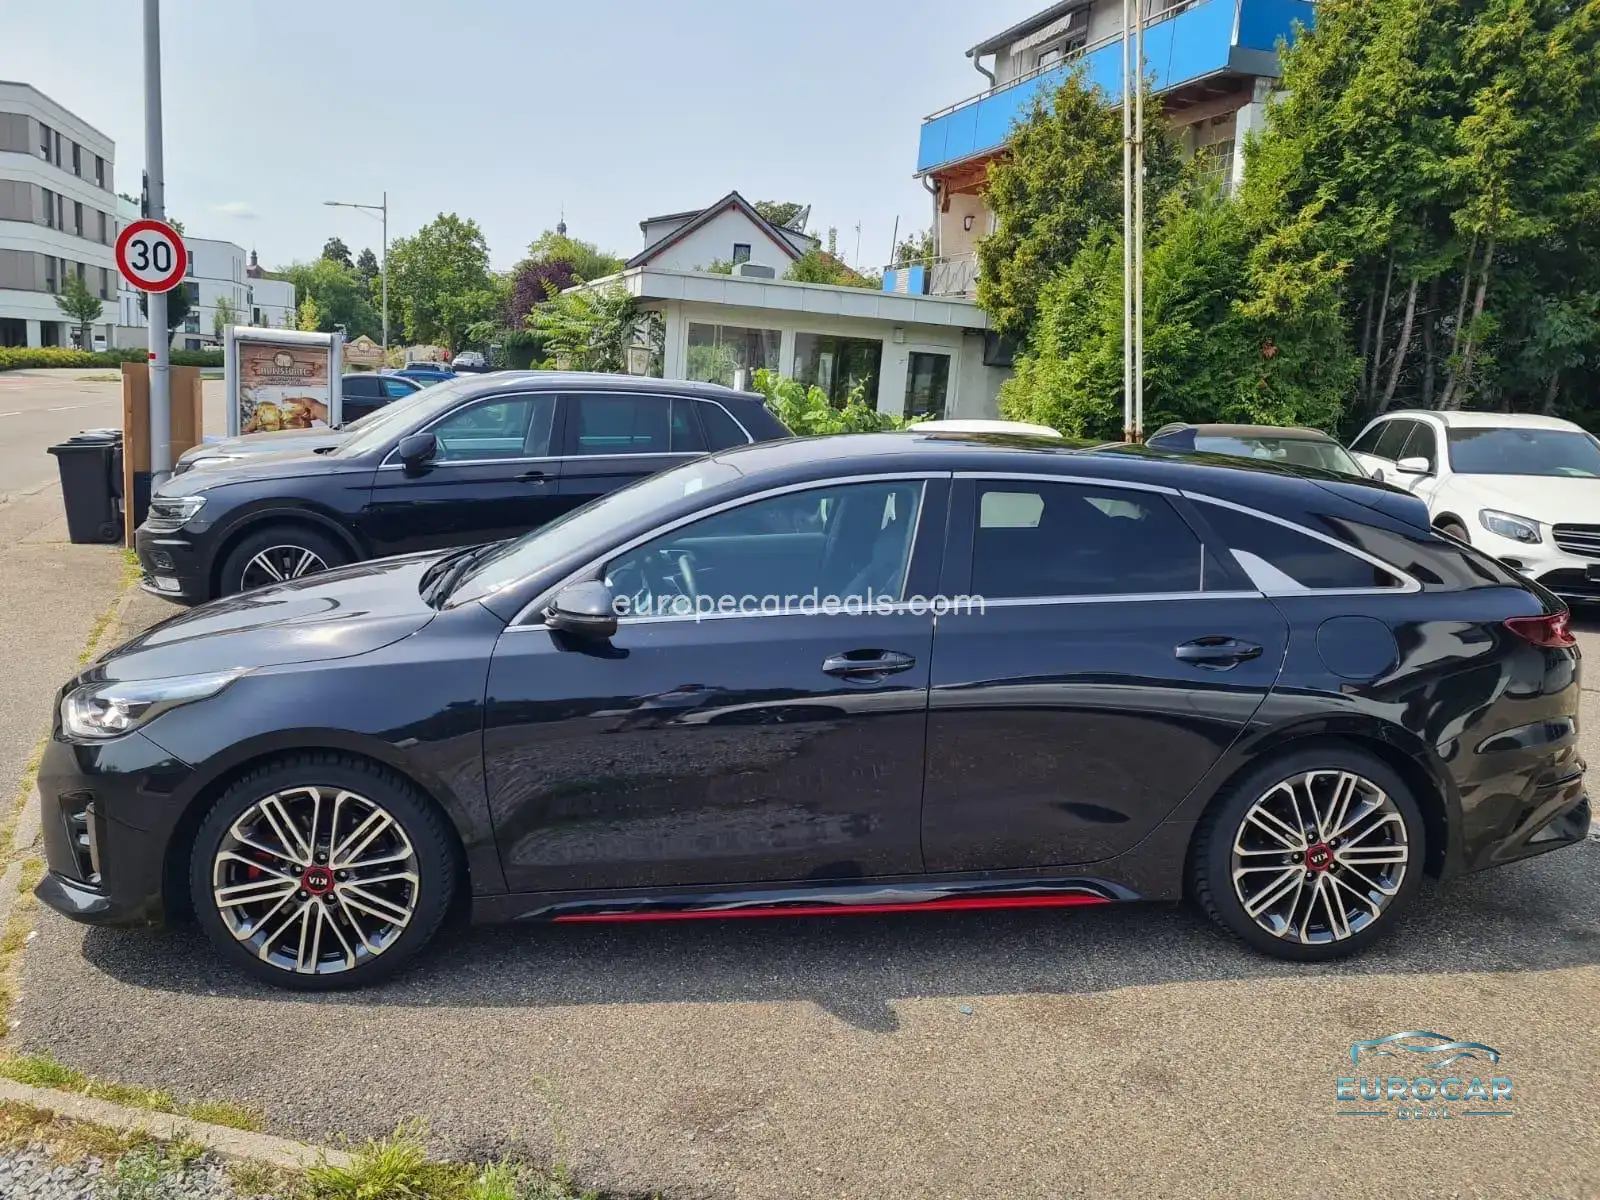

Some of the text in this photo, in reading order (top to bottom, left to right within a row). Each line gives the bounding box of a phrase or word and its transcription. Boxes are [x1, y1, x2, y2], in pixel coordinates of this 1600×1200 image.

[131, 239, 171, 272] 30
[1310, 852, 1329, 863] KIA
[308, 876, 328, 886] KIA
